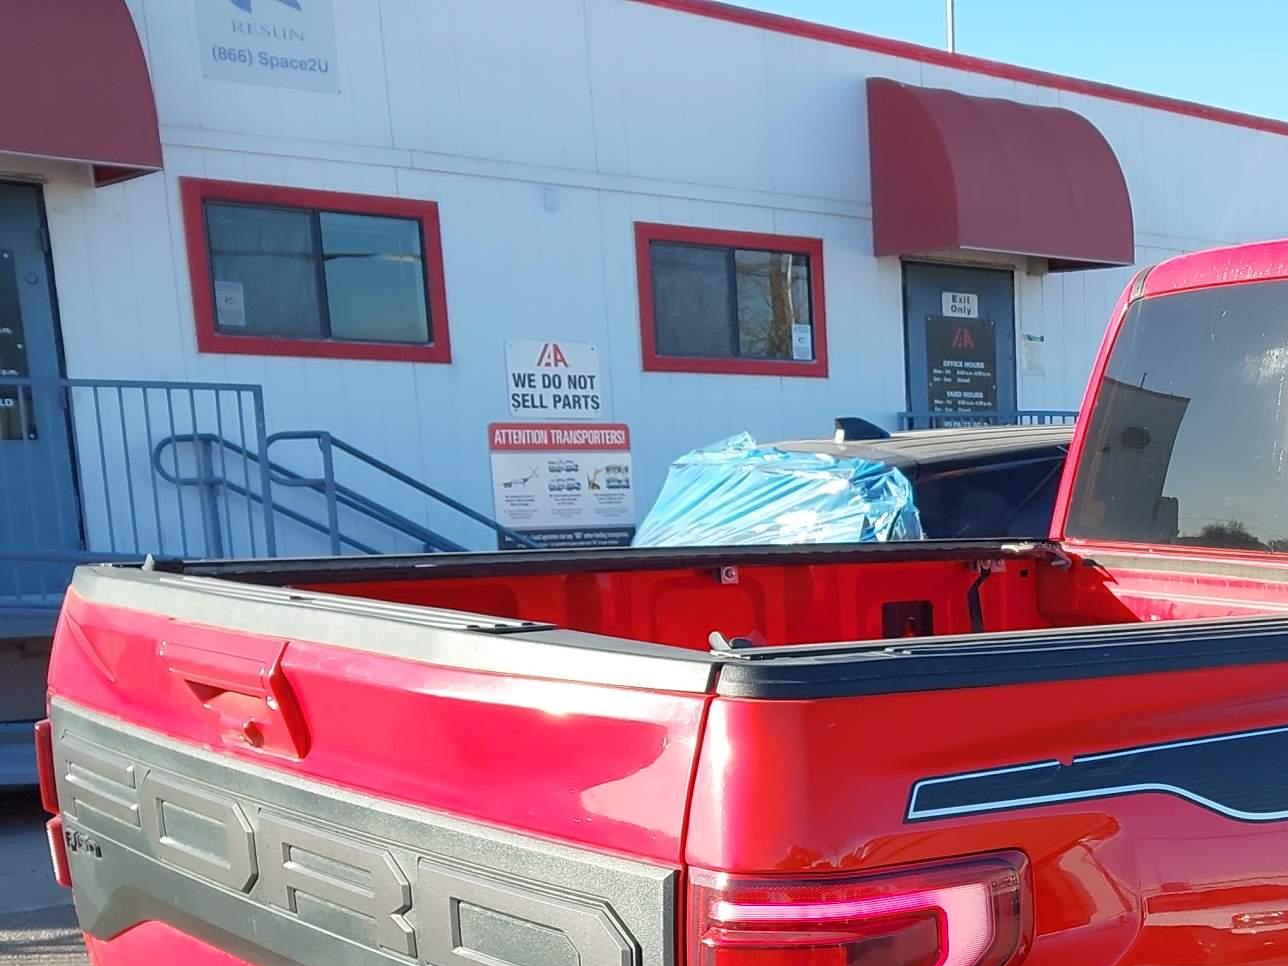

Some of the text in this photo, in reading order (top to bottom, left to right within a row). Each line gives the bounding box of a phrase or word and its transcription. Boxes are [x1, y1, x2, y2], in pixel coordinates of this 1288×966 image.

[211, 45, 329, 73] (866) Space2U
[951, 294, 970, 304] Exit
[950, 304, 972, 316] Only
[943, 360, 985, 369] OFFICE HOURS
[512, 373, 596, 390] WE DO NOT
[511, 393, 600, 410] SELL PARTS
[946, 390, 984, 399] YARD HOURS
[494, 429, 626, 445] ATTENTION TRANSPORTERS!
